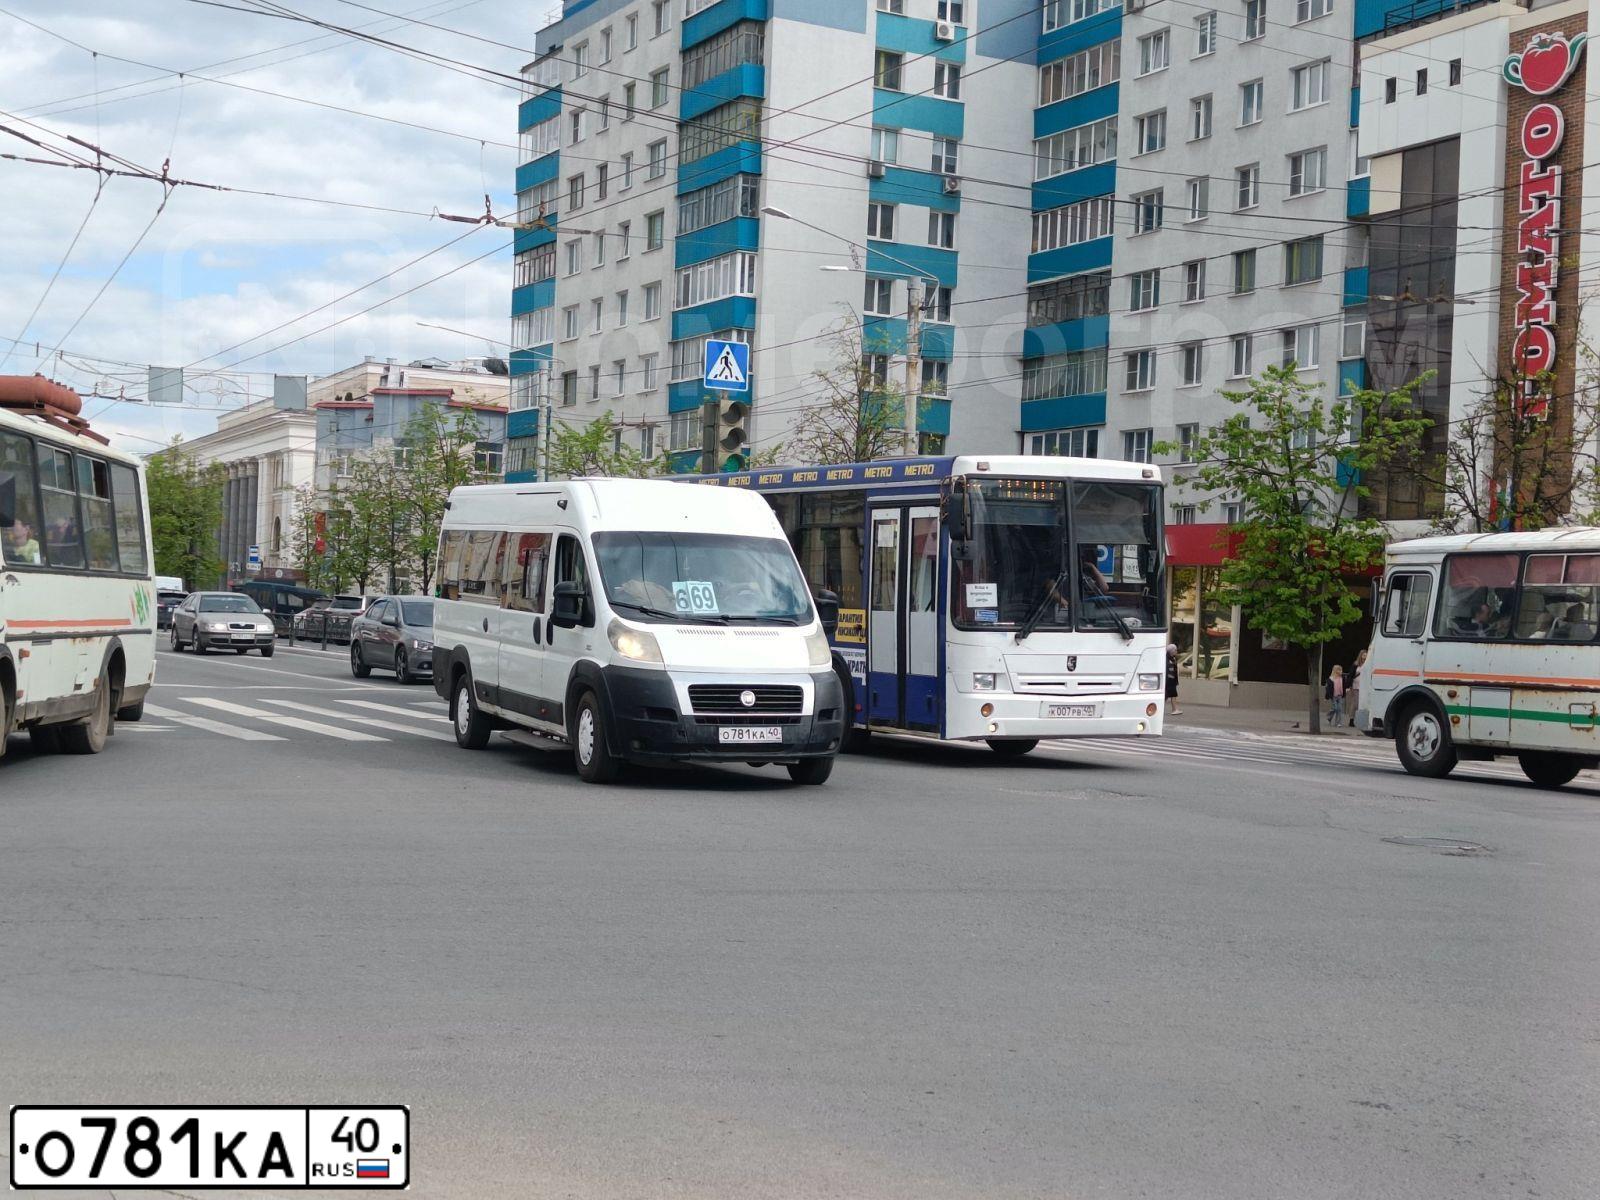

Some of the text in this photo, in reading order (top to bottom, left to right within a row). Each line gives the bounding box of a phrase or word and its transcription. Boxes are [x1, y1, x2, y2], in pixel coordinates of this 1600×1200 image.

[728, 476, 750, 486] METRO
[759, 474, 782, 485] METRO
[793, 471, 818, 483] METRO
[827, 469, 853, 480] METRO
[864, 466, 892, 478] METRO
[904, 464, 935, 476] METRO
[676, 586, 714, 609] 6 69
[838, 613, 863, 624] АРАНТИЯ
